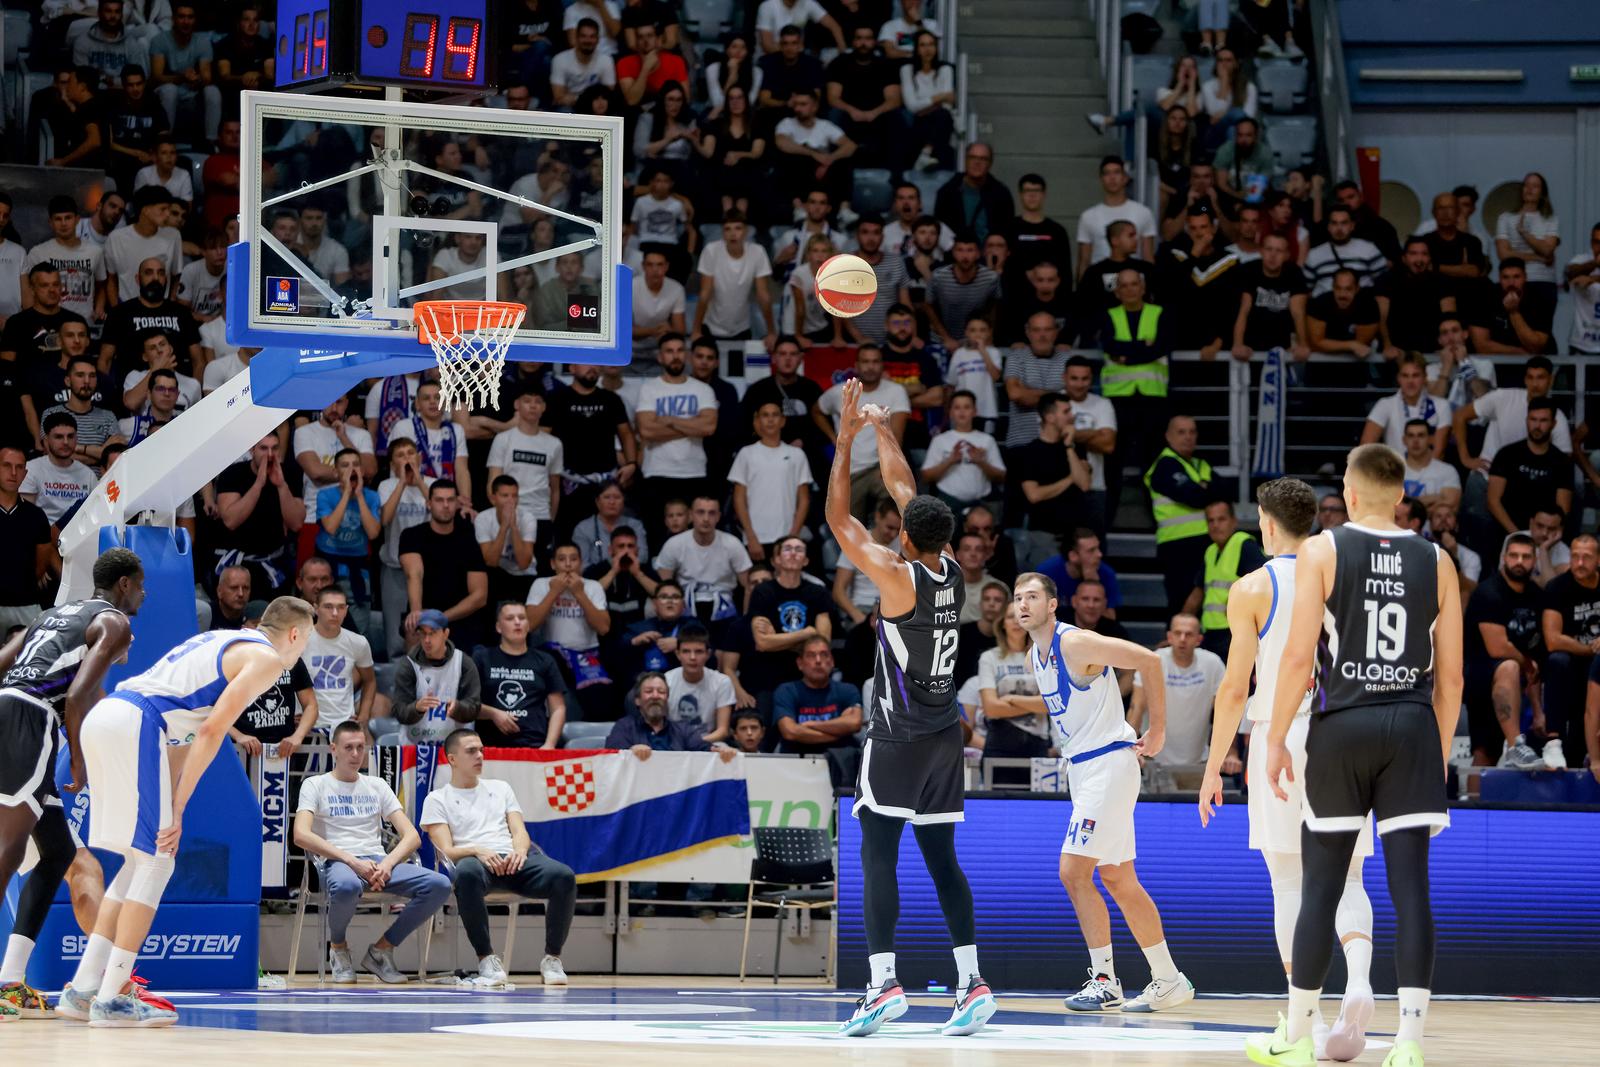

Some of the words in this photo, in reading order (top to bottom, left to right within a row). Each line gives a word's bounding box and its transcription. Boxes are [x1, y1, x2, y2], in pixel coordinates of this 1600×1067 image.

[423, 19, 480, 79] 14
[583, 306, 597, 318] LG
[133, 316, 181, 332] TORCIDA
[54, 389, 103, 402] elle
[1370, 551, 1402, 576] LAKIĆ
[1365, 577, 1405, 597] mts
[934, 609, 957, 625] mts
[1363, 599, 1407, 662] 19
[16, 628, 58, 665] 11
[930, 628, 959, 677] 12
[1341, 661, 1420, 683] GLOBOS
[255, 715, 286, 729] ZADAR
[263, 771, 284, 843] MCM
